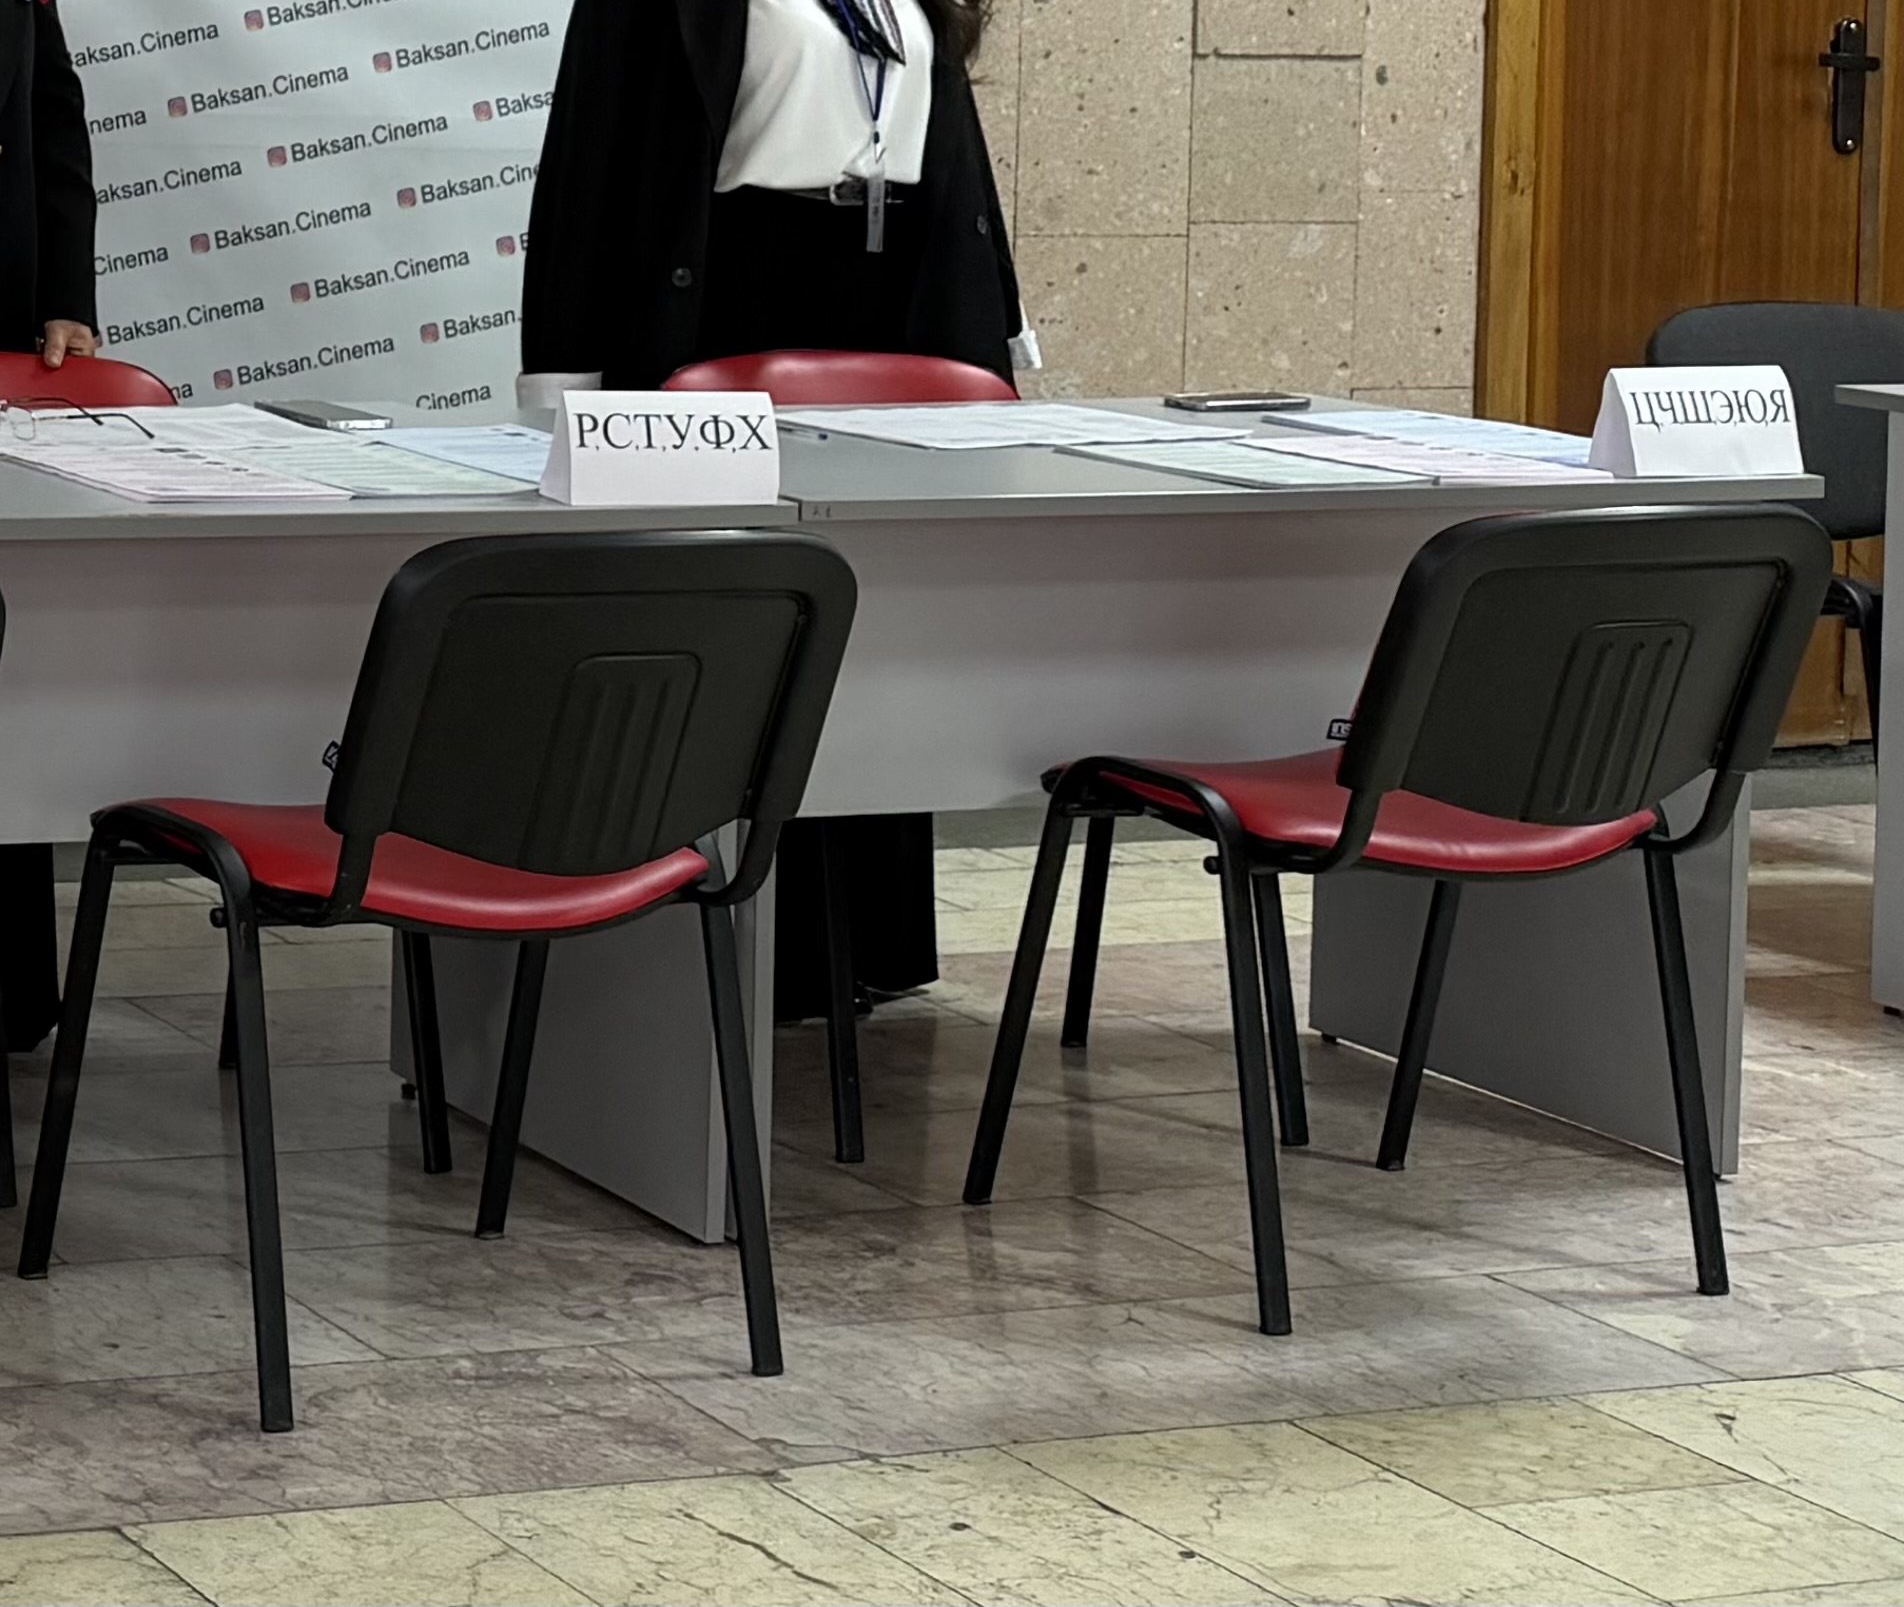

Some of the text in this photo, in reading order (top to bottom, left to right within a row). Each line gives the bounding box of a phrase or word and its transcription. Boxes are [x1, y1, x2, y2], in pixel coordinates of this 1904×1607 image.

[69, 23, 219, 68] aksan.Cinema
[395, 20, 551, 69] Baksan.Cinema
[192, 65, 349, 113] Baksan.Cinema
[291, 115, 449, 163] Baksan.Cinema
[97, 159, 242, 205] aksan.Cinema
[214, 201, 372, 250] Baksan.Cinema
[314, 249, 470, 299] Baksan.Cinema
[107, 295, 265, 345] Baksan.Cinema
[443, 307, 522, 339] Baksan.
[237, 335, 396, 386] Baksan.Cinema
